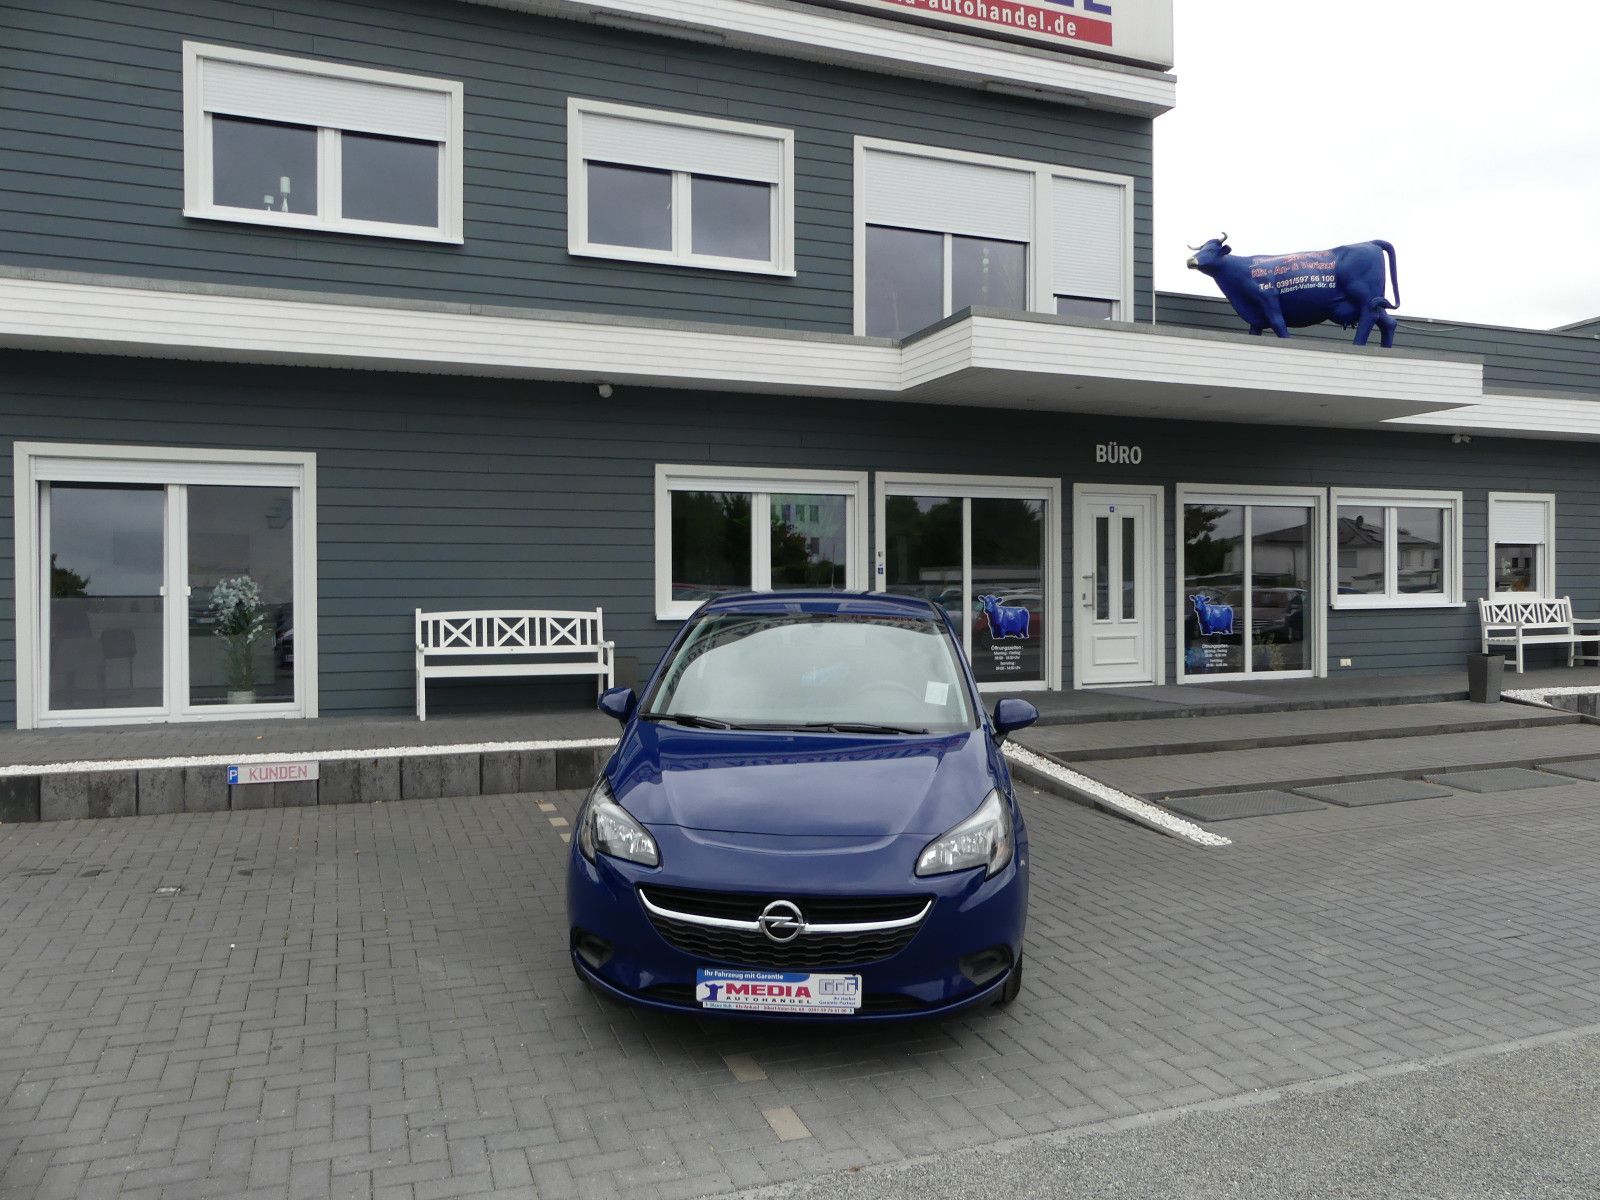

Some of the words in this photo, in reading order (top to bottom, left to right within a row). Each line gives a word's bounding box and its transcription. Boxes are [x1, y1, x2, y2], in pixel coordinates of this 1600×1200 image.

[1259, 282, 1274, 290] Tel.
[1276, 275, 1309, 288] 0391/597
[1096, 441, 1142, 465] BÜRO
[248, 765, 308, 781] KUNDEN
[714, 970, 744, 980] Fahrzeug
[725, 983, 812, 998] MEDIA
[726, 996, 812, 1004] AUTOHANDEL
